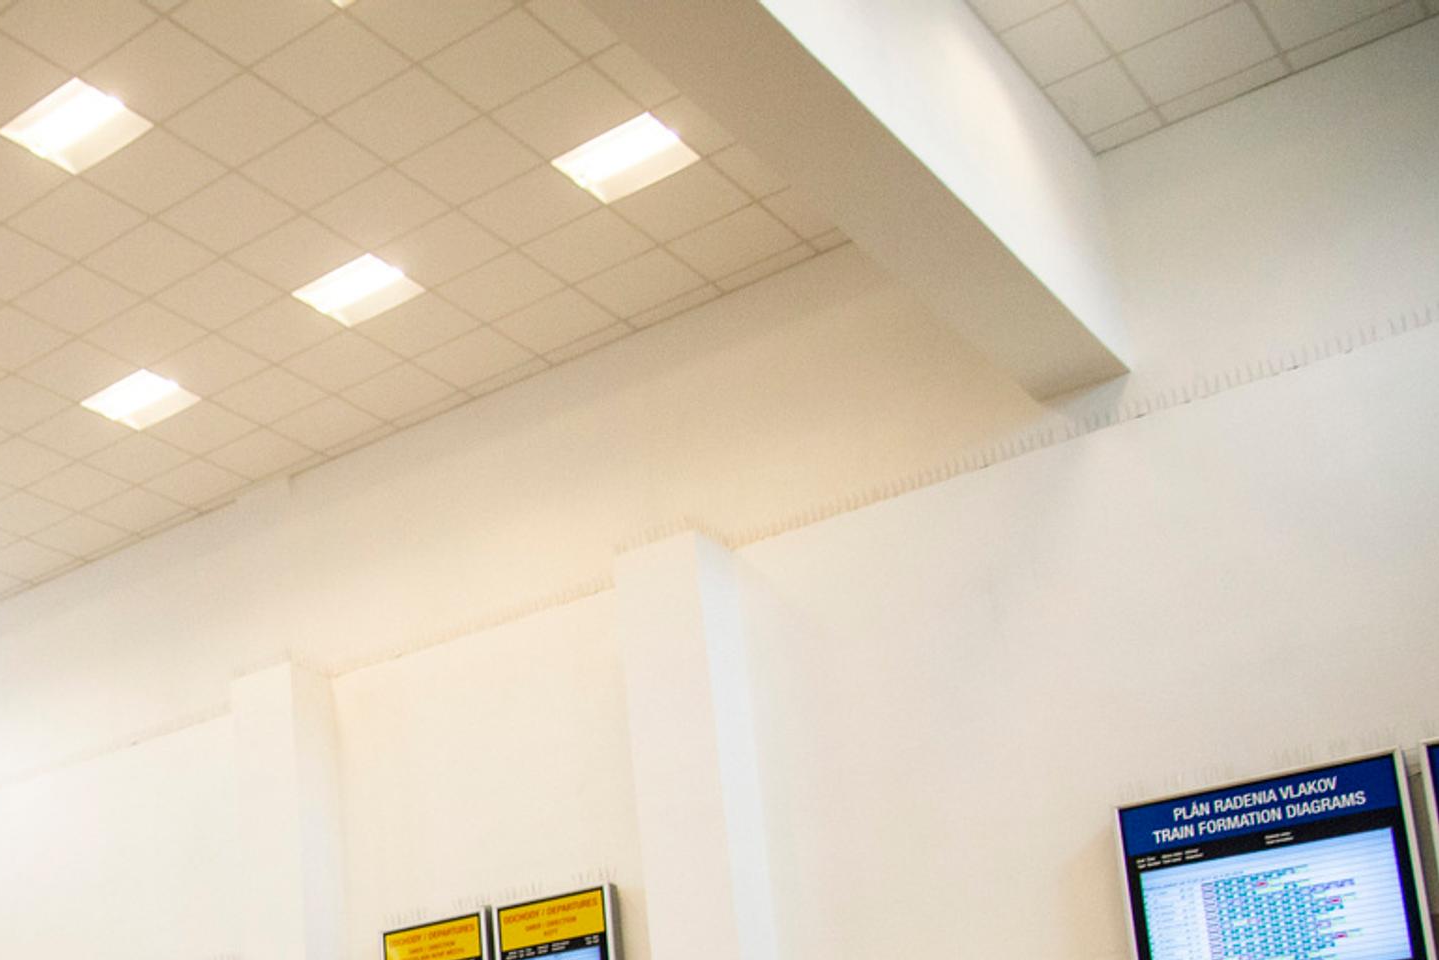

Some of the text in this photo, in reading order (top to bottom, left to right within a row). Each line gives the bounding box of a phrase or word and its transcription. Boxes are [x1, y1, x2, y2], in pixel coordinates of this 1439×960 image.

[1152, 790, 1367, 845] TRAIN FORMATION DIAGRAMS
[1173, 776, 1338, 822] PLÁN RADENIA VLAKOV
